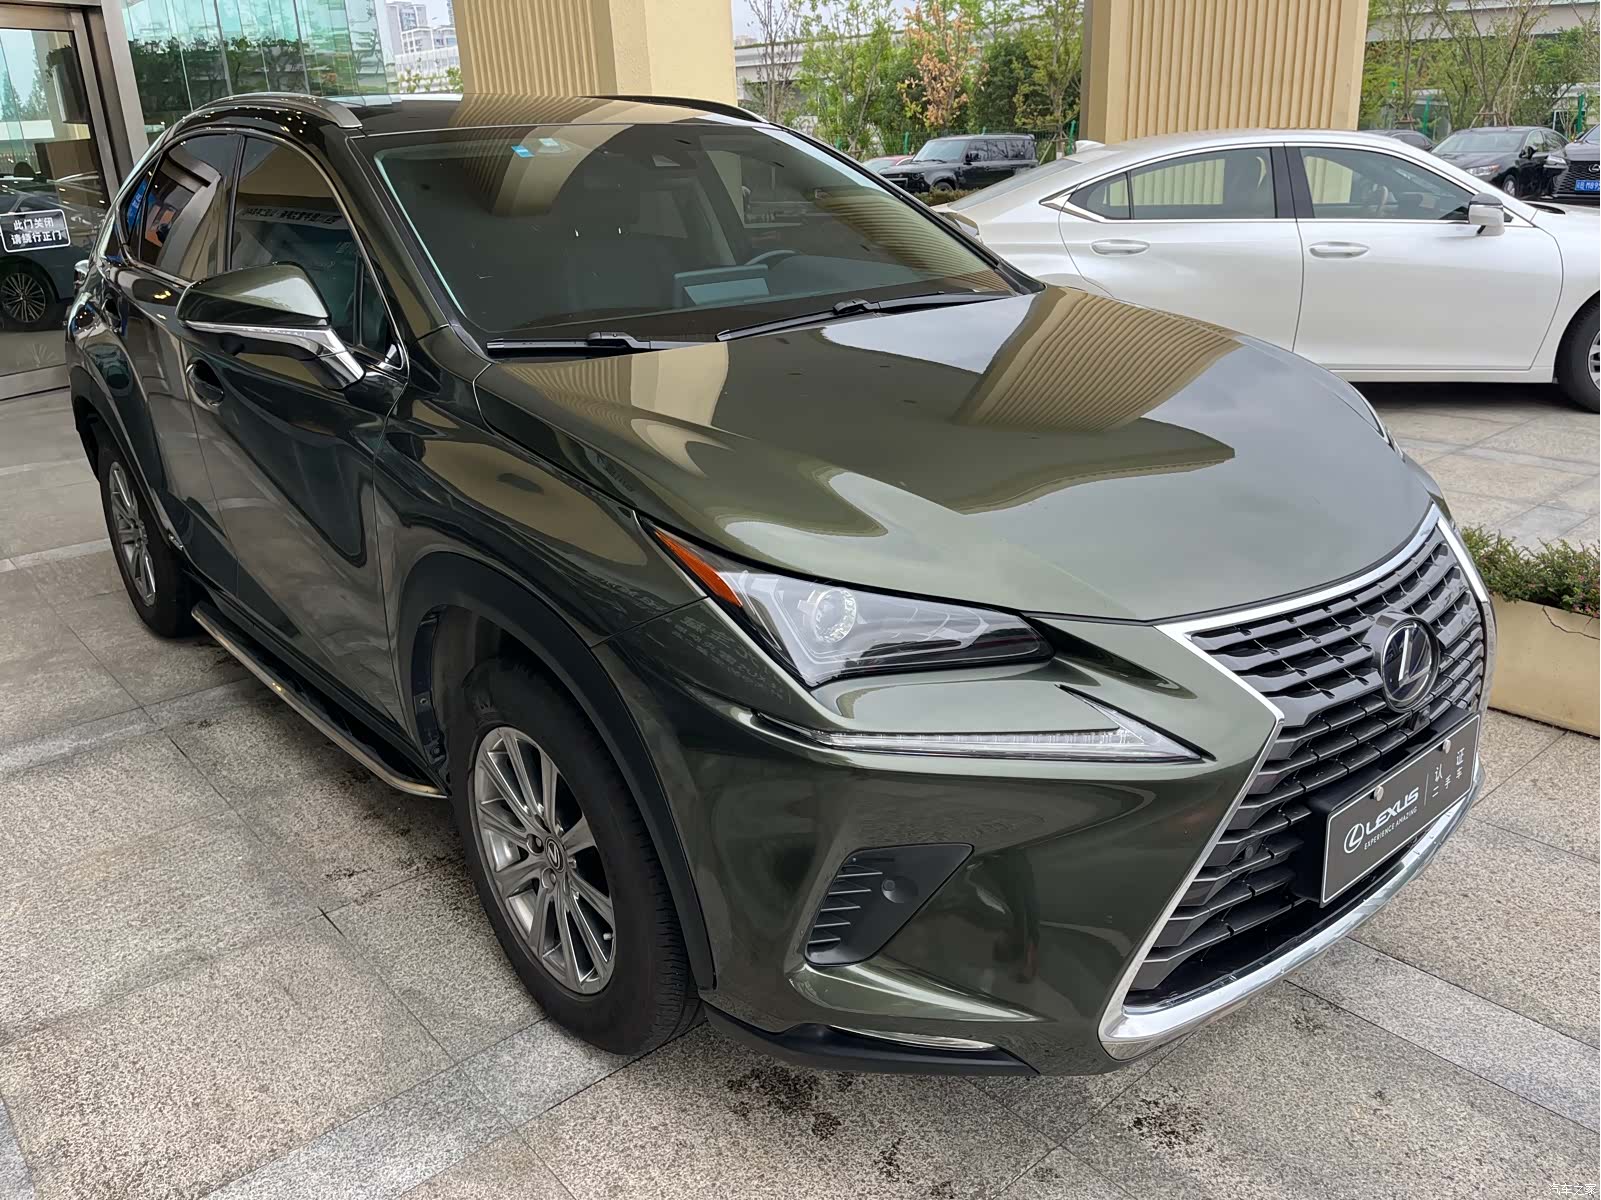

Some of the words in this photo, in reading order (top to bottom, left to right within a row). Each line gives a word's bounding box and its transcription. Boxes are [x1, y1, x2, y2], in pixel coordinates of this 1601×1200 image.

[11, 230, 62, 245] 请绕行正门
[13, 217, 54, 231] 此门关闭
[1365, 787, 1419, 835] LEXUS
[1364, 822, 1395, 850] EXPERIENCE
[1395, 806, 1418, 829] AMAZING
